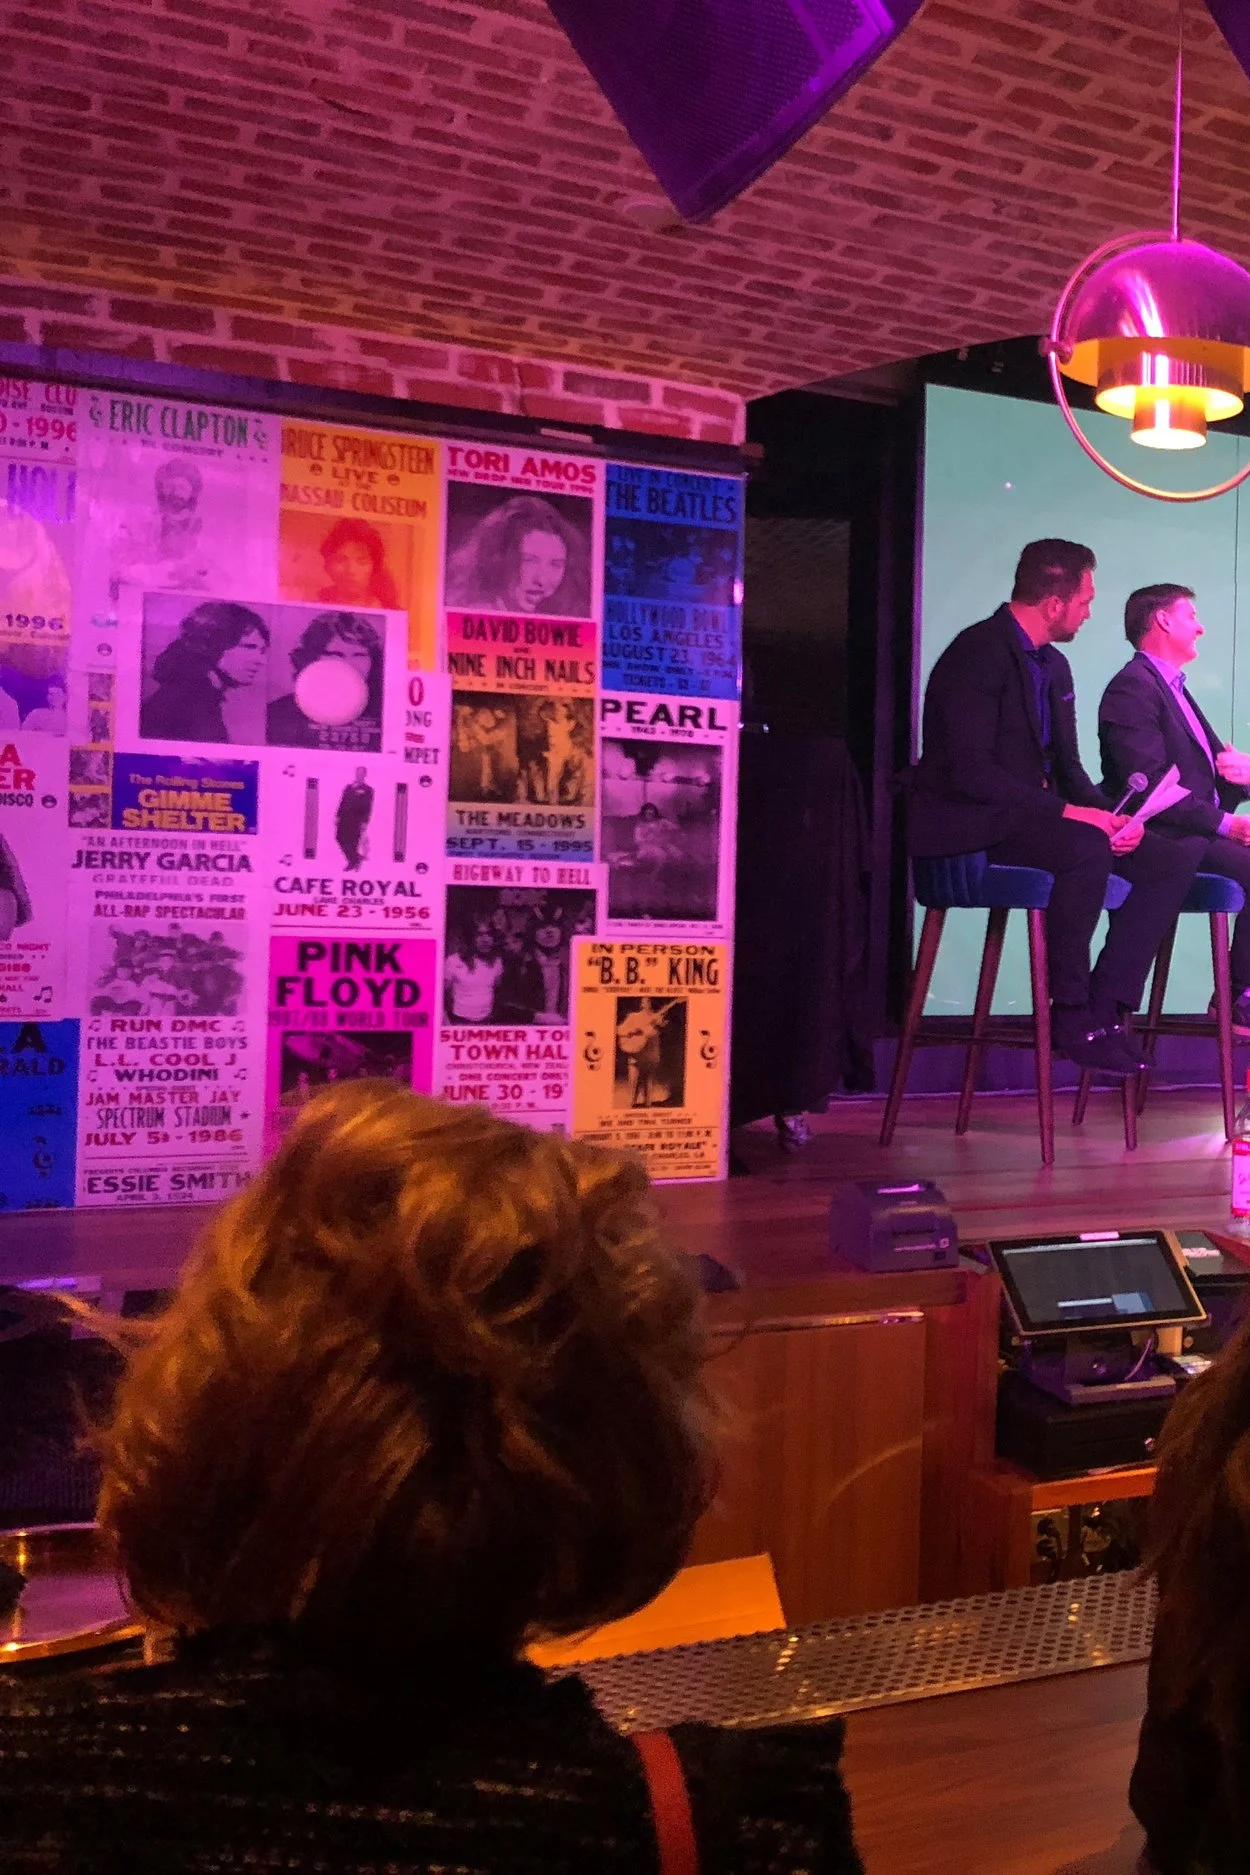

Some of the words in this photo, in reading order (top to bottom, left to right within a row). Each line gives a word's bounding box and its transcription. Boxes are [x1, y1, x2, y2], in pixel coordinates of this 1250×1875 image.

[109, 399, 153, 436] ERIC
[159, 405, 250, 449] CLAPTON
[281, 427, 327, 462] RUCE
[332, 466, 379, 484] LIVE
[447, 446, 510, 473] TORI
[520, 456, 597, 485] AMOS
[351, 491, 427, 519] COLISEUM
[646, 487, 738, 524] BEATLES
[6, 613, 65, 632] 1996
[462, 615, 520, 644] DAVID
[524, 620, 583, 648] BOWIE
[608, 624, 642, 642] LOS
[496, 655, 536, 681] INCH
[543, 658, 597, 685] NAILS
[600, 698, 729, 732] PEARL
[137, 788, 234, 812] GIMME
[121, 807, 247, 833] SHELTER
[455, 809, 490, 827] THE
[496, 811, 587, 830] MEADOWS
[446, 837, 506, 851] SEPT.
[516, 839, 536, 852] 15
[70, 849, 151, 871] JERRY
[155, 851, 254, 874] GARCIA
[186, 875, 235, 888] DEAD
[531, 866, 551, 884] TO
[273, 875, 335, 897] CAFE
[341, 878, 423, 899] ROYAL
[272, 902, 329, 918] JUNE
[335, 904, 363, 919] 23
[381, 905, 431, 920] 1956
[298, 941, 404, 974] PINK
[591, 943, 614, 955] IN
[619, 943, 716, 957] PERSON
[667, 957, 720, 986] KING
[276, 975, 422, 1009] FLOYD
[109, 1018, 163, 1033] RUN
[170, 1019, 222, 1033] DMC
[440, 1029, 528, 1043] SUMMER
[86, 1036, 119, 1050] THE
[124, 1035, 198, 1051] BEASTIE
[203, 1035, 249, 1050] BOYS
[449, 1044, 519, 1061] TOWN
[148, 1052, 217, 1067] COOL
[223, 1052, 238, 1067] J
[113, 1067, 220, 1083] WHODINI
[85, 1092, 121, 1107] JAM
[127, 1090, 200, 1105] MASTER
[208, 1089, 242, 1104] JAY
[496, 1083, 524, 1101] 30
[96, 1106, 166, 1130] SPECTRUM
[173, 1105, 233, 1129] STADIUM
[84, 1131, 138, 1147] JULY
[187, 1128, 246, 1145] 1986
[85, 1174, 161, 1195] ESSIE
